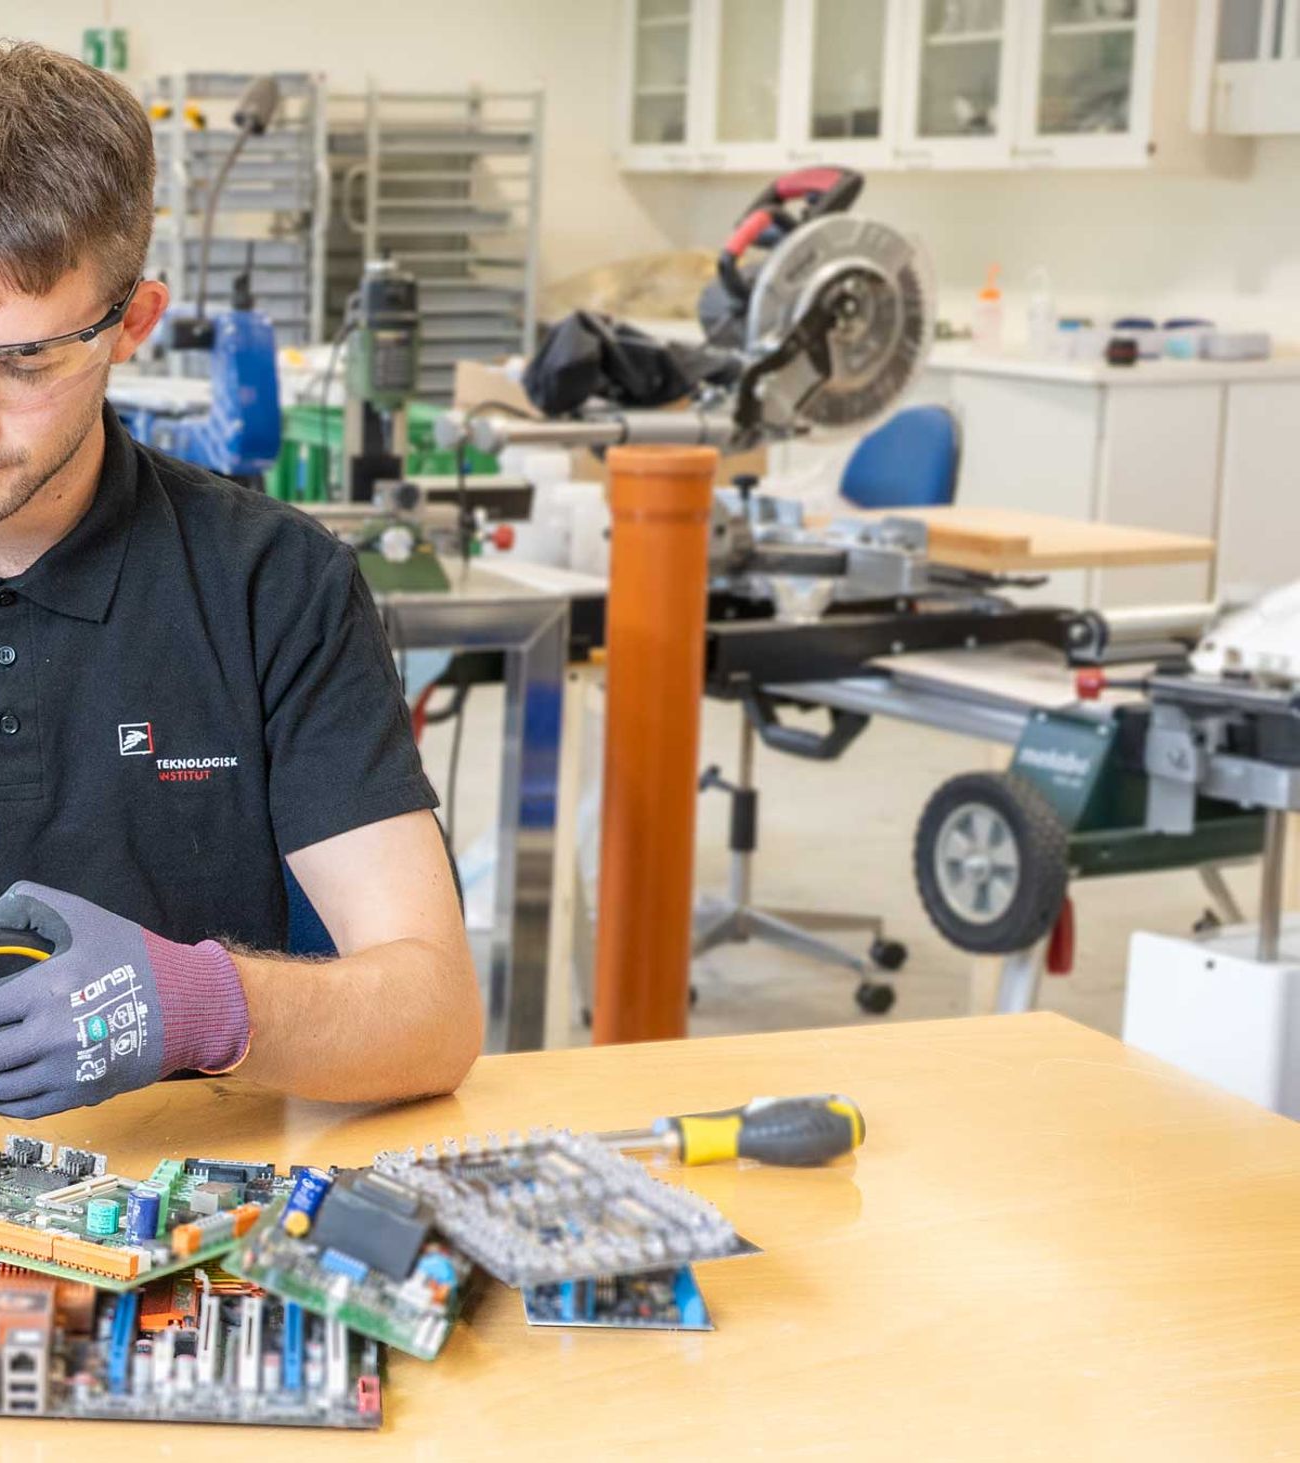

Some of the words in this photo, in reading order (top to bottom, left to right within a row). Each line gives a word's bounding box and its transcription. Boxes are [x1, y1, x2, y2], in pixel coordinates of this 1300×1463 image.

[156, 757, 238, 769] TEKNOLOGISK
[159, 770, 211, 782] INSTITUT
[71, 966, 128, 1007] GUIDE
